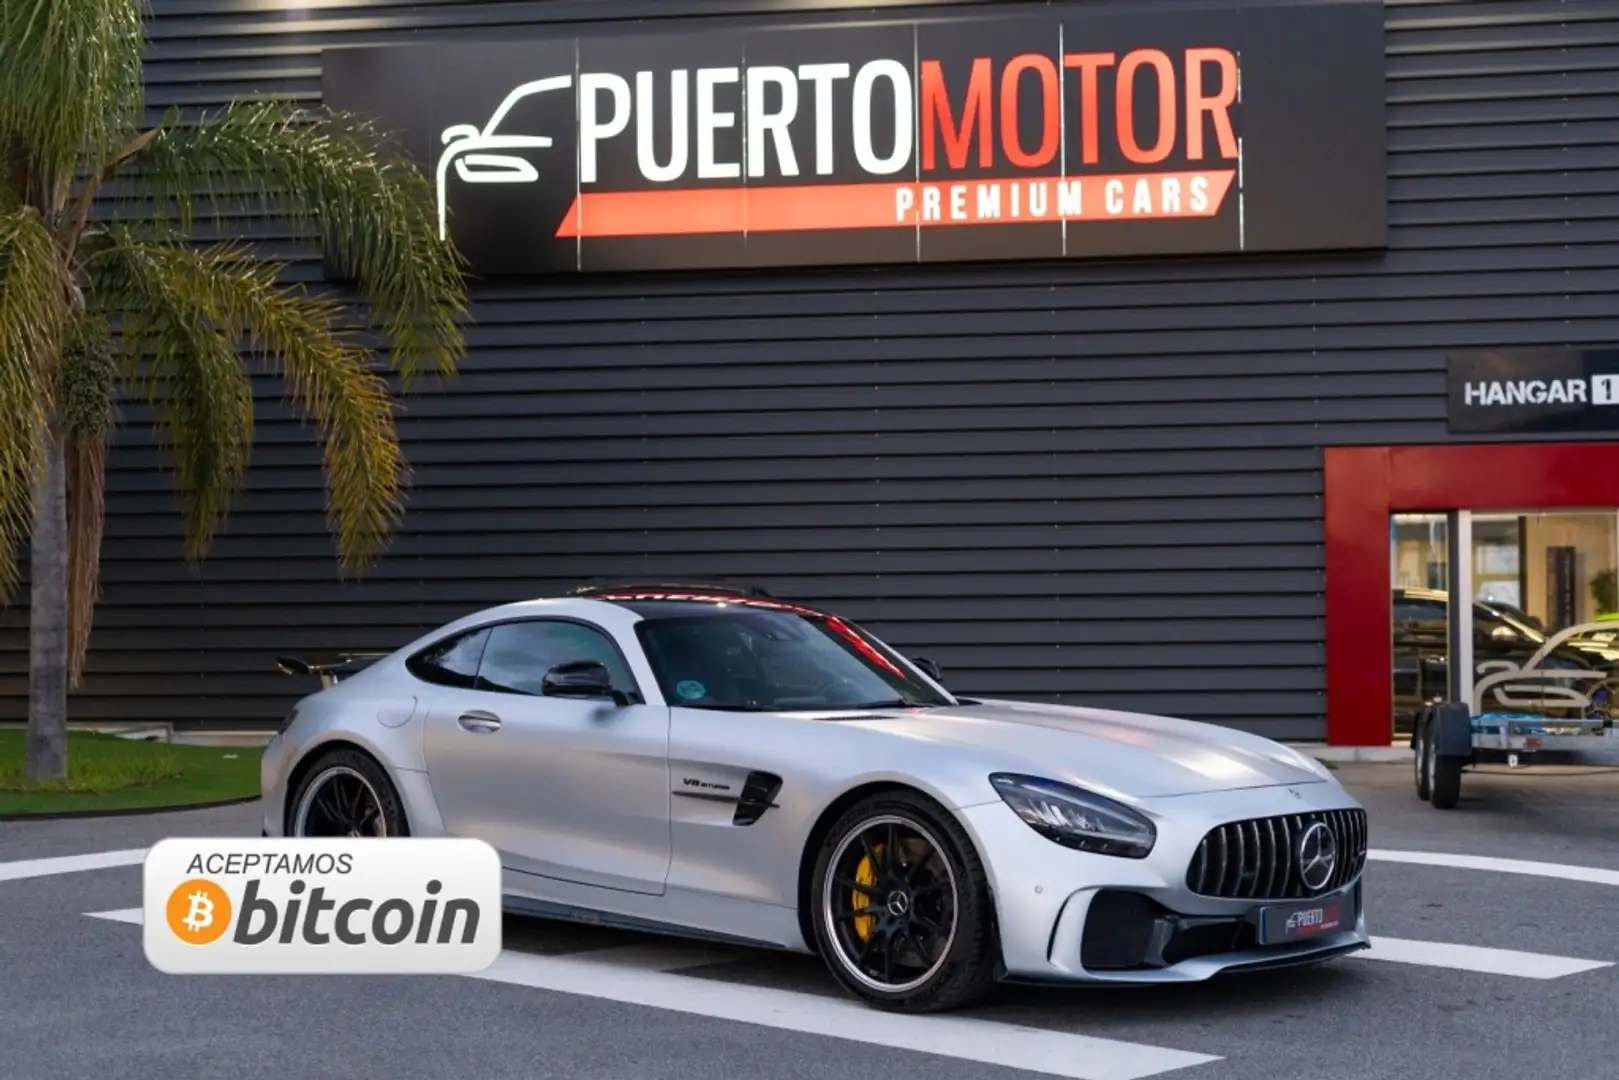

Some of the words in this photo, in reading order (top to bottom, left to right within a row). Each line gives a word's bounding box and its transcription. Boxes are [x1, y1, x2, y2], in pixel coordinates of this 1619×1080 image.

[894, 181, 1083, 222] PREMIUM
[1103, 177, 1211, 216] CARS
[1464, 379, 1587, 406] HANGAR
